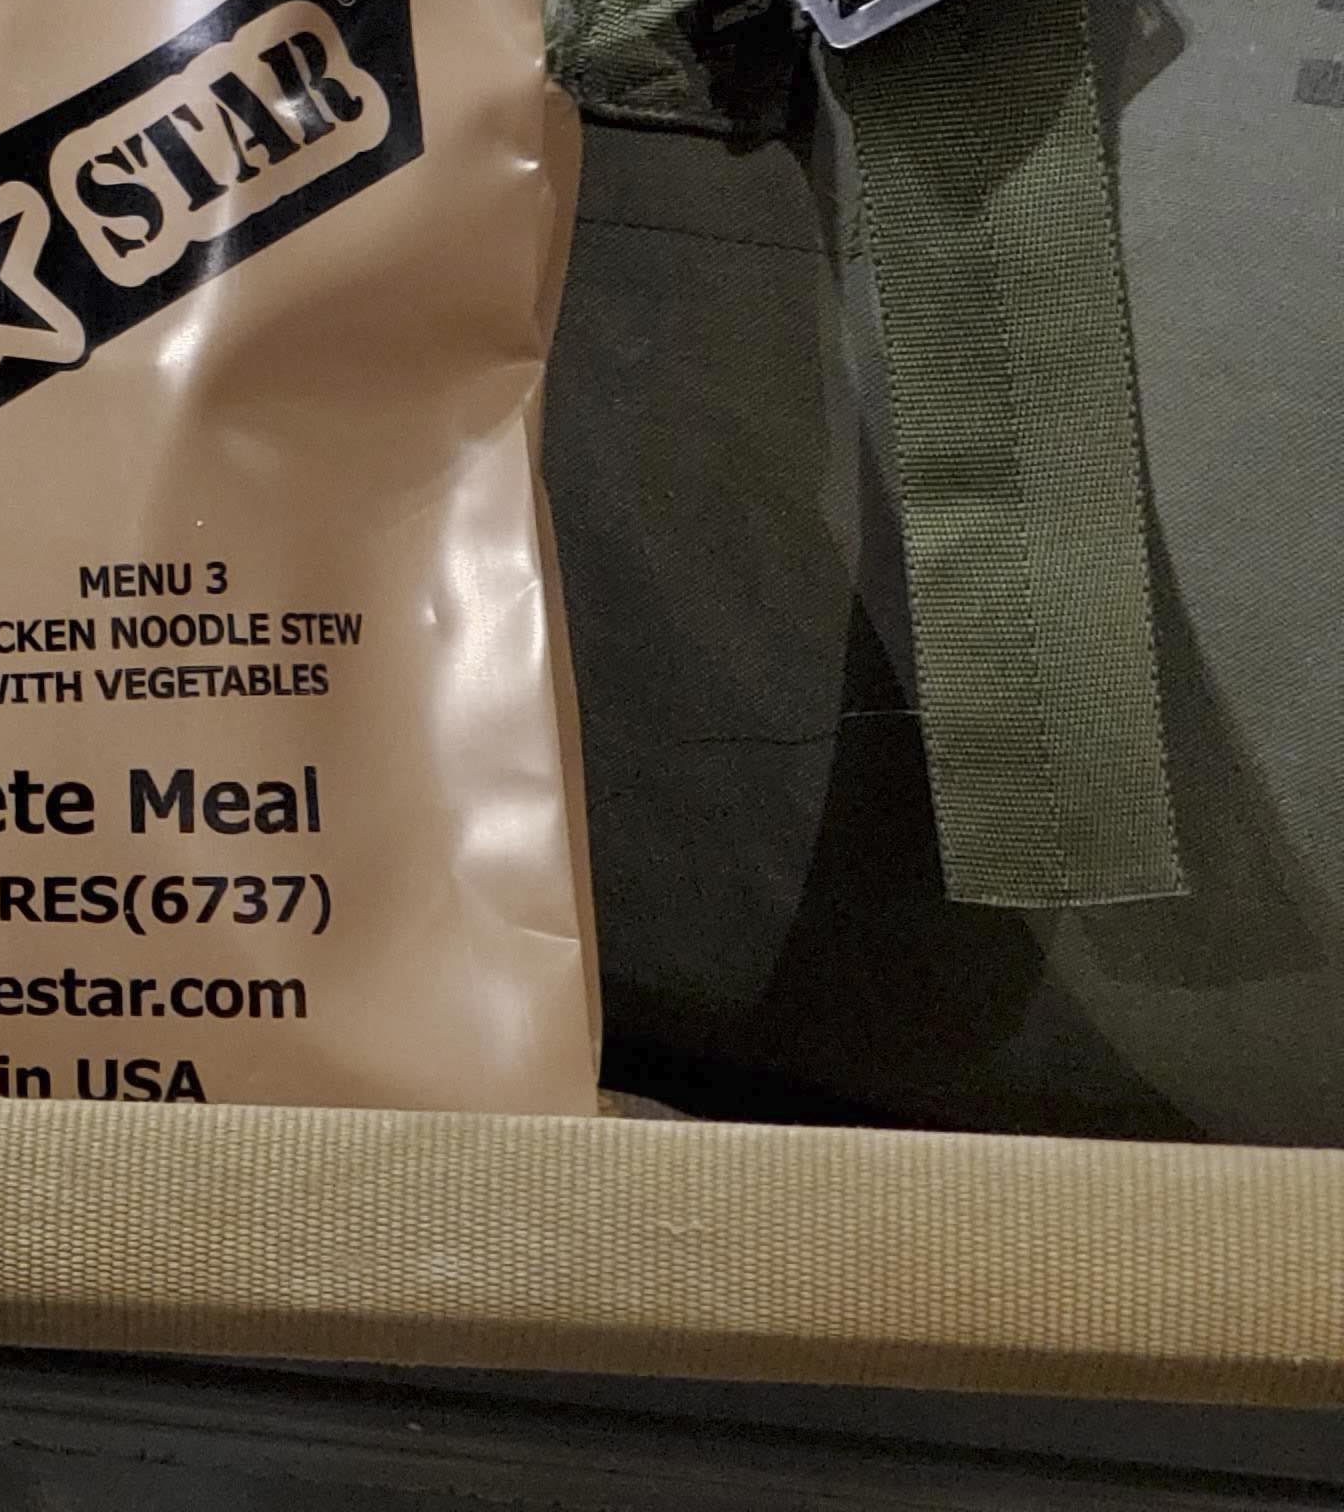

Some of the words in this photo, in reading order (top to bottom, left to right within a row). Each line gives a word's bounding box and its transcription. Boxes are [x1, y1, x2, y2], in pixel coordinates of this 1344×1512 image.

[76, 30, 365, 259] STAR
[79, 562, 192, 599] MENU
[206, 561, 229, 595] 3
[111, 613, 271, 650] NOODLE
[281, 612, 363, 646] STEW
[95, 663, 329, 700] VEGETABLES
[129, 766, 322, 835] Meal
[76, 1058, 208, 1104] USA
